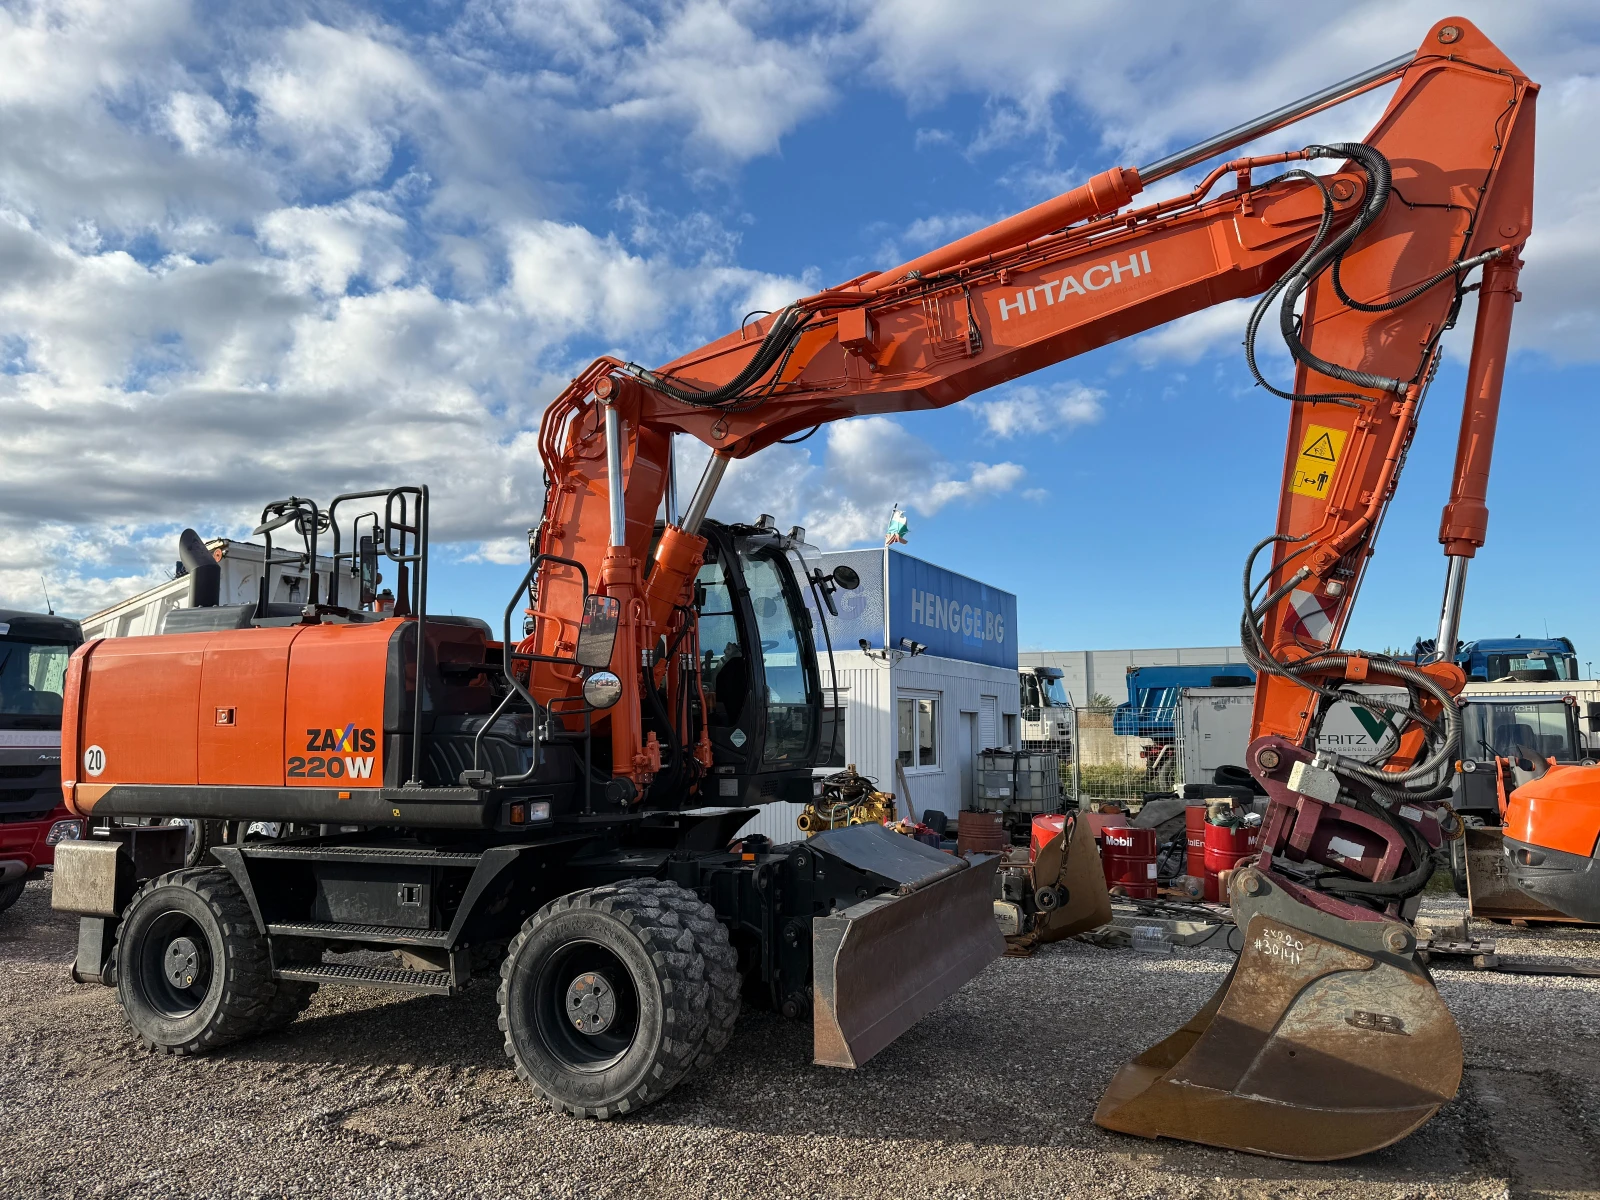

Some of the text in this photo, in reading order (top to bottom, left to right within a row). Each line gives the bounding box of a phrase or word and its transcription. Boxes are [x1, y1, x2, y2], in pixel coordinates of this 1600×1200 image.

[998, 250, 1152, 321] HITACHI
[911, 588, 1004, 643] HENGGE.BG
[1495, 705, 1536, 713] HITACHI
[306, 723, 376, 752] ZAXIS
[1317, 734, 1367, 745] FRITZ
[88, 749, 102, 771] 20
[287, 756, 375, 778] 220W
[1105, 835, 1133, 847] Mobil
